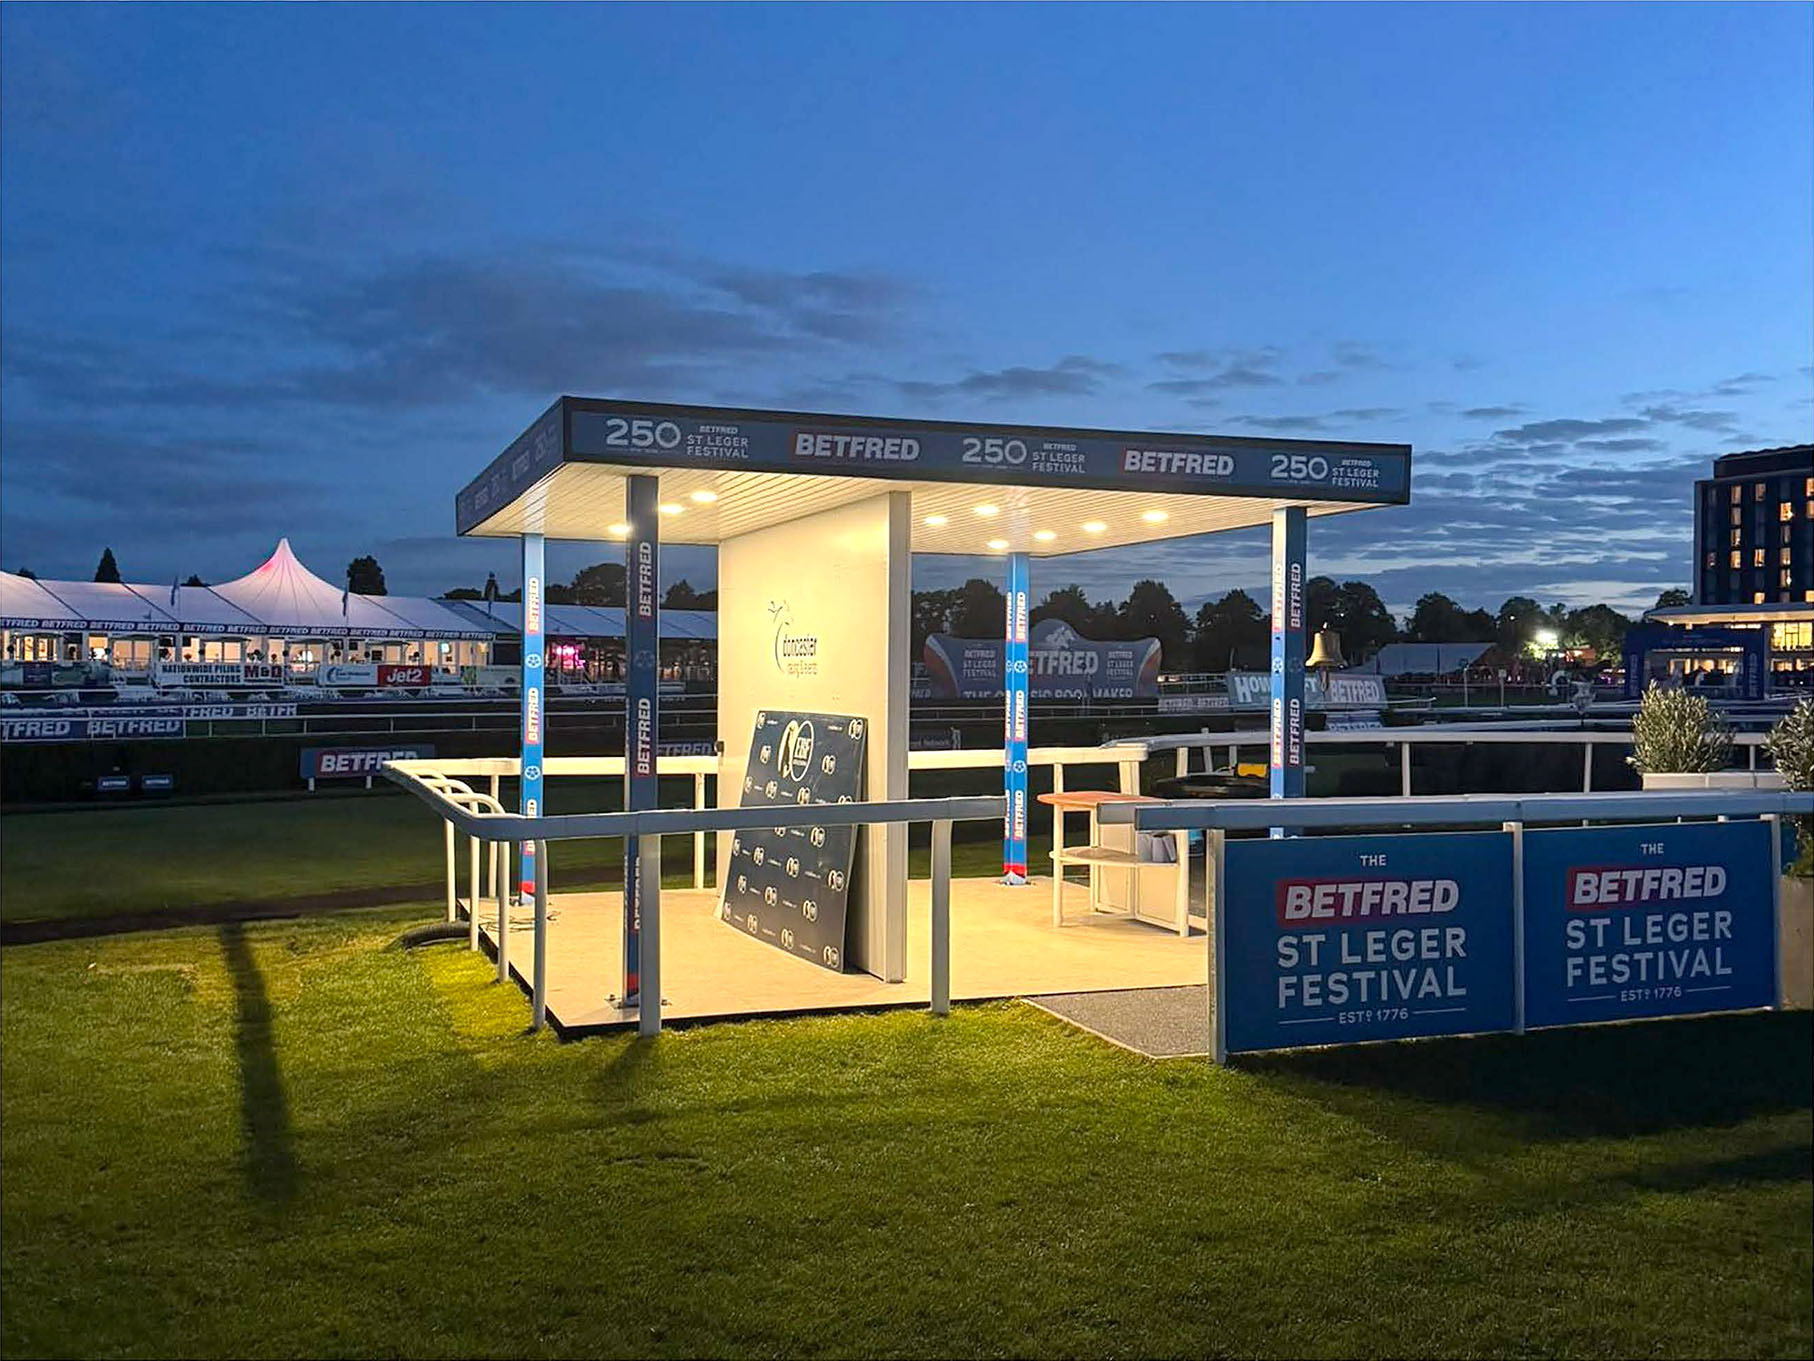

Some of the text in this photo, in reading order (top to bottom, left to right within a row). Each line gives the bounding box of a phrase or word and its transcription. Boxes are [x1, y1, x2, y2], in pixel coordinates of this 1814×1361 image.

[606, 417, 682, 449] 250
[687, 434, 749, 449] ST LEGER
[687, 446, 750, 459] FESTIVAL
[796, 433, 921, 461] BETFRED
[962, 438, 1027, 465] 250
[1032, 451, 1085, 464] ST LEGER
[1032, 462, 1086, 474] FESTIVAL
[1124, 450, 1235, 477] BETFRED
[1271, 454, 1329, 480] 250
[1332, 467, 1379, 479] ST LEGER
[1332, 478, 1380, 488] FESTIVAL
[640, 542, 652, 616] BETFRED
[1291, 564, 1300, 628] BETFRED
[1330, 680, 1381, 702] BETFRED
[88, 719, 181, 735] BETFRED
[528, 687, 539, 741] BETFRED
[638, 698, 651, 774] BETFRED
[1289, 698, 1299, 765] BETFRED
[1360, 855, 1387, 867] THE
[1639, 843, 1664, 855] THE
[1573, 866, 1728, 905] BETFRED
[1284, 880, 1459, 920] BETFRED
[1566, 911, 1733, 950] ST LEGER
[1277, 927, 1467, 968] ST LEGER
[1567, 946, 1733, 988] FESTIVAL
[1278, 966, 1467, 1009] FESTIVAL
[1377, 1008, 1408, 1022] 1776
